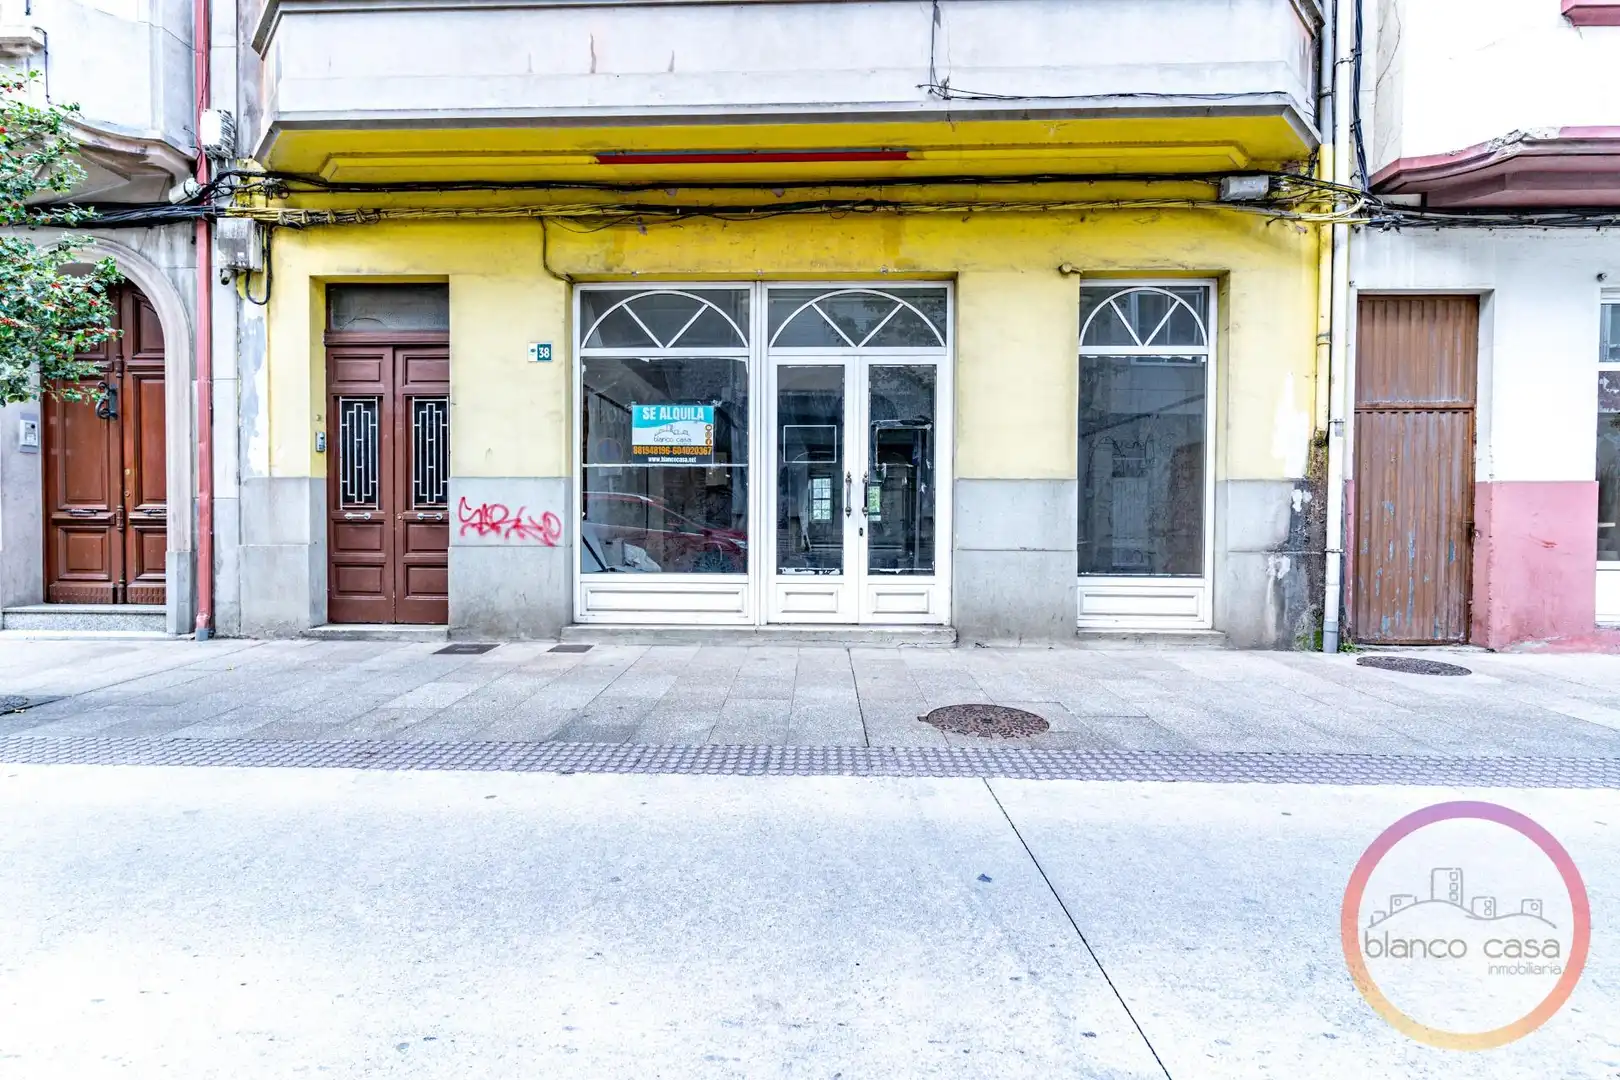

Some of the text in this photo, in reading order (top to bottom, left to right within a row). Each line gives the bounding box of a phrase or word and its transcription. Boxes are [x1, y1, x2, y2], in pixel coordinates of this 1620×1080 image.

[538, 347, 550, 358] 38
[642, 407, 656, 420] SE
[660, 407, 704, 420] ALQUILA
